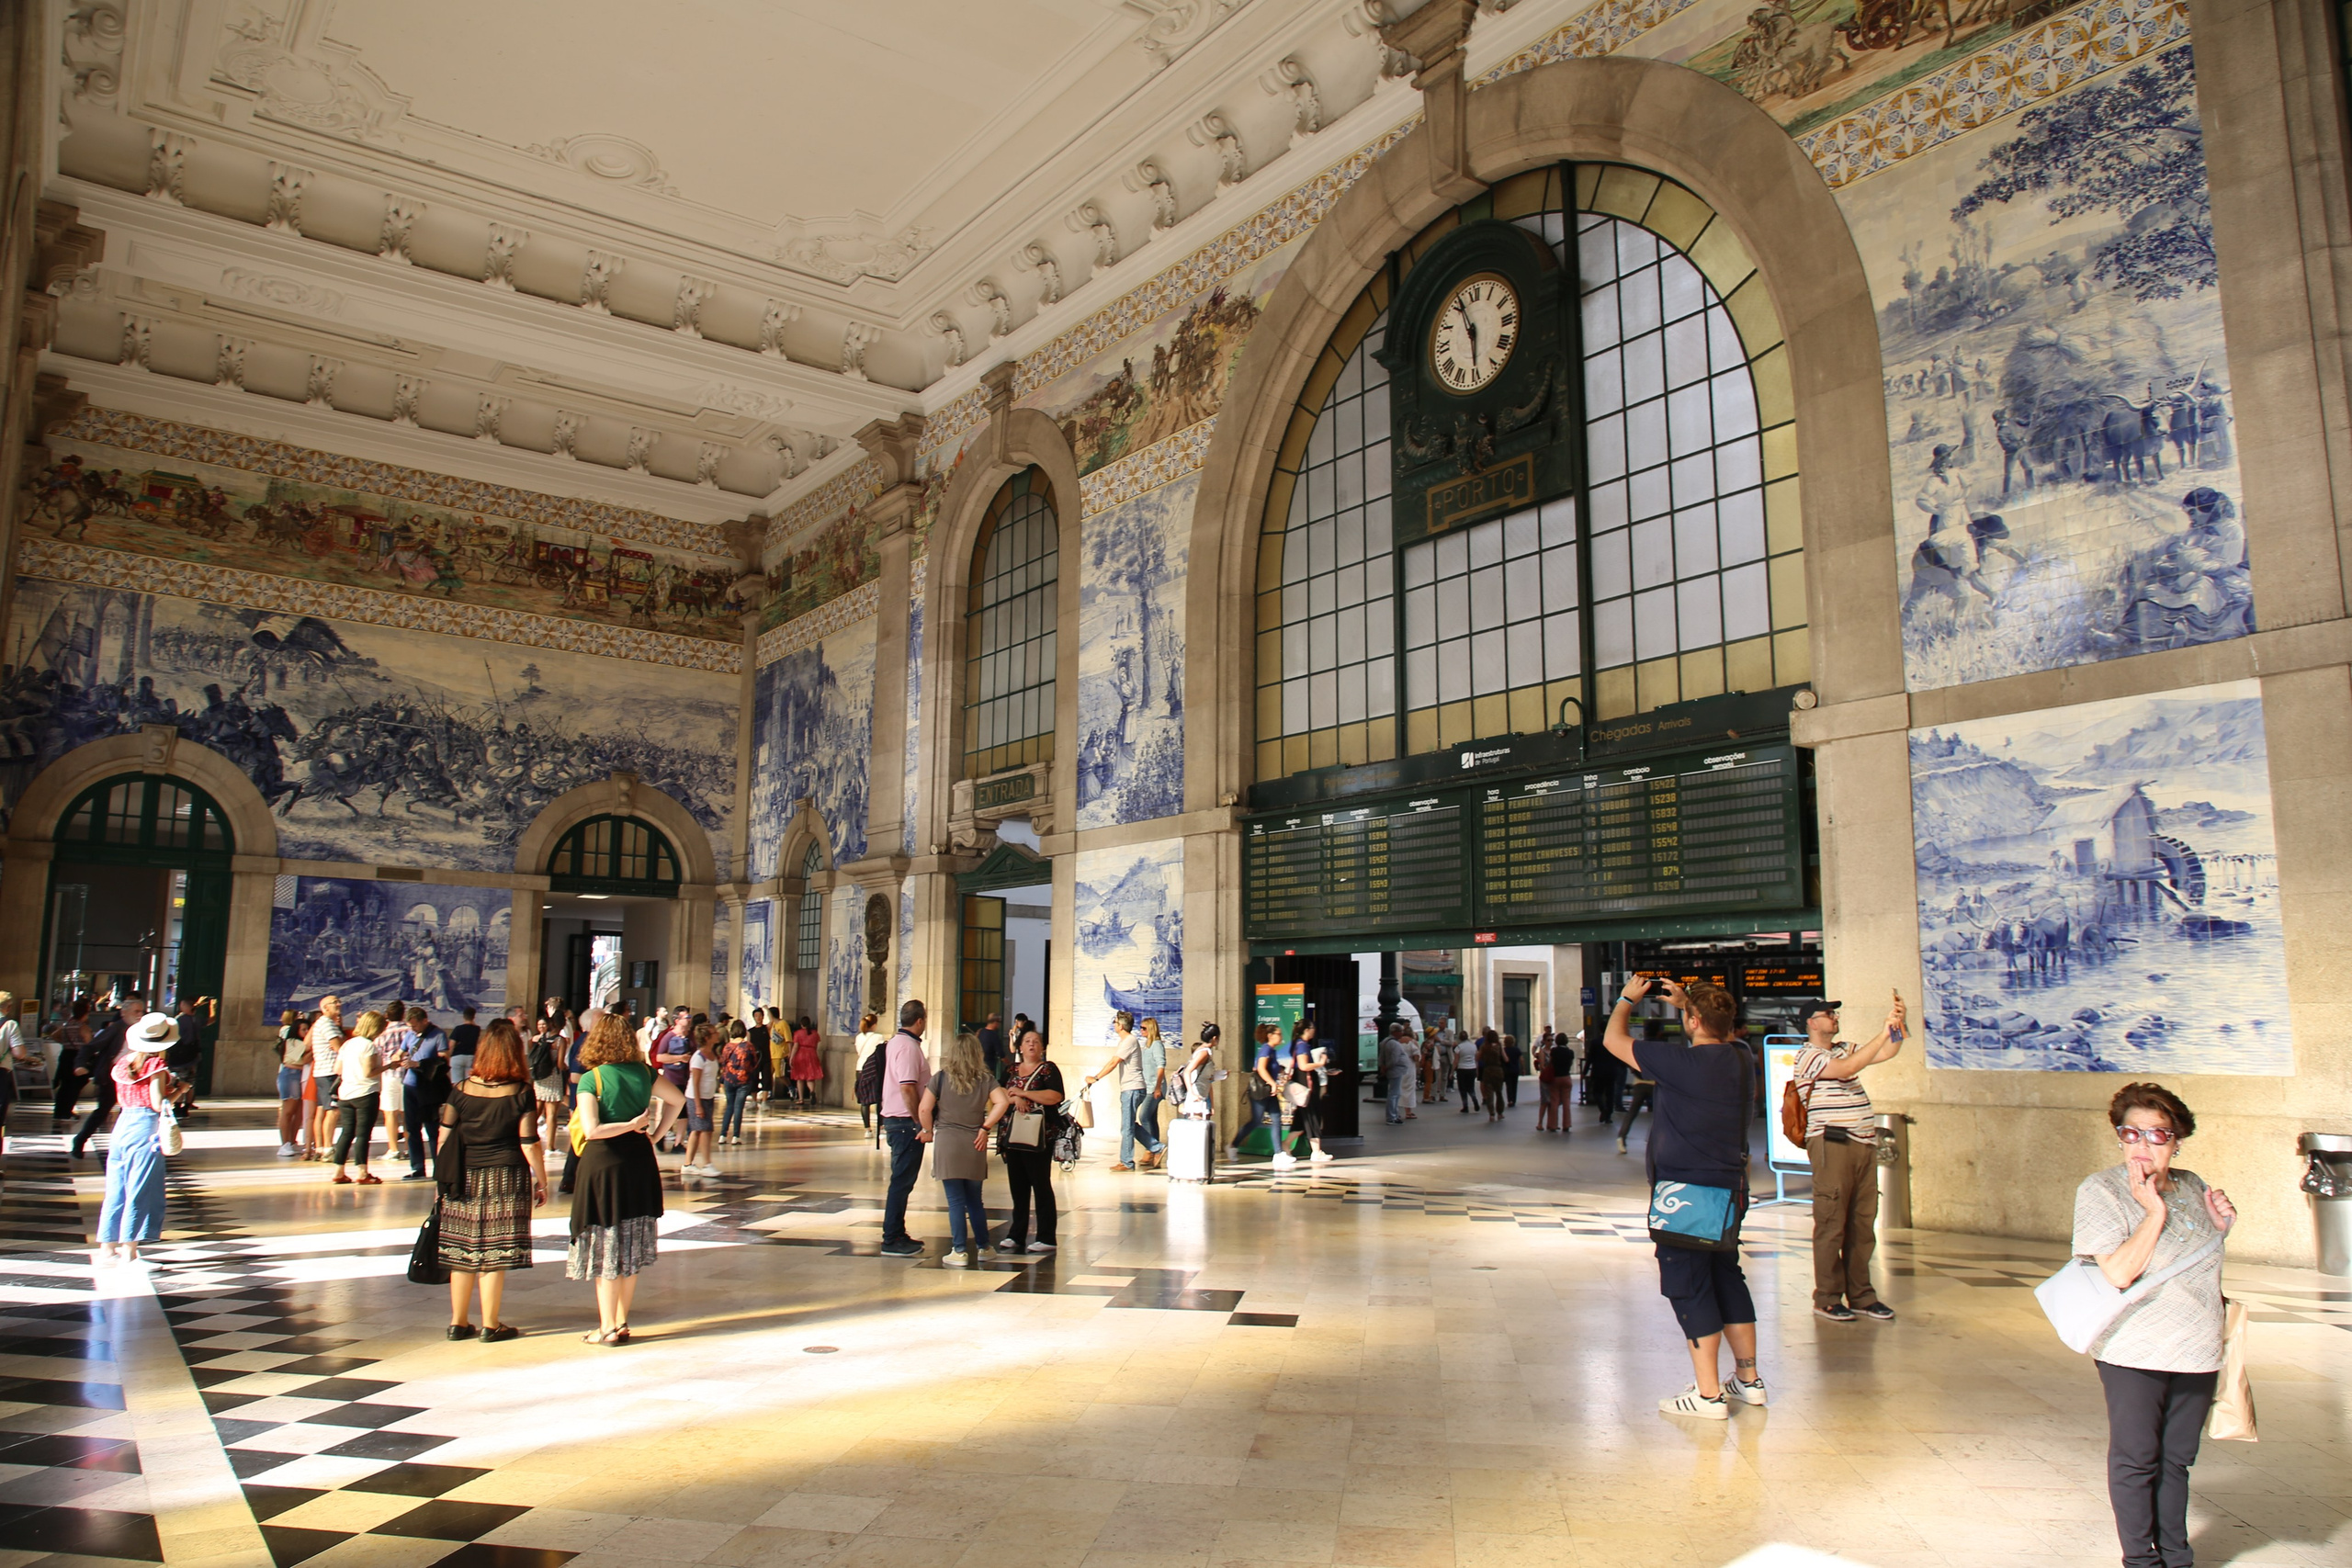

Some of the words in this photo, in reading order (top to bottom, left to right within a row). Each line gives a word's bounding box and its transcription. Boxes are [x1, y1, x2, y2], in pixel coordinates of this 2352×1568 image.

[1442, 468, 1515, 509] PORTO
[1590, 722, 1652, 742] Chegadas
[1658, 716, 1691, 731] Arrivals
[1475, 747, 1510, 758] Infraestruturas
[1482, 757, 1499, 765] Portugal
[1703, 752, 1746, 764] observações
[1623, 766, 1650, 775] comboio
[978, 778, 1029, 805] ENTRADA
[1509, 797, 1544, 809] PENAFIEL
[1650, 778, 1676, 790] 15422
[1525, 780, 1559, 791] procedência
[1409, 798, 1439, 807] observações
[1484, 816, 1505, 825] 18H15
[1509, 812, 1531, 823] BRAGA
[1600, 799, 1630, 811] SUBURB
[1650, 793, 1676, 805] 15238
[1510, 826, 1527, 836] OVAR
[1591, 817, 1596, 826] 5
[1600, 813, 1630, 825] SUBURB
[1651, 807, 1677, 819] 15832
[1485, 841, 1505, 852] 18H25
[1510, 838, 1536, 849] AVEIRO
[1601, 828, 1630, 839] SUBURB
[1510, 852, 1532, 863] MARCO
[1536, 847, 1578, 859] CANAVESES
[1601, 841, 1631, 852] SUBURB
[1652, 837, 1678, 848] 15542
[1369, 855, 1387, 864] 15425
[1486, 868, 1506, 877] 18H35
[1510, 863, 1551, 875] GUIMARAES
[1602, 856, 1632, 867] SUBURB
[1652, 852, 1678, 863] 15172
[1369, 867, 1387, 876] 15171
[1510, 878, 1532, 888] REGUA
[1663, 866, 1679, 876] 874
[1486, 894, 1507, 903] 18H55
[1511, 892, 1532, 902] BRAGA
[1603, 885, 1633, 895] SUBURB
